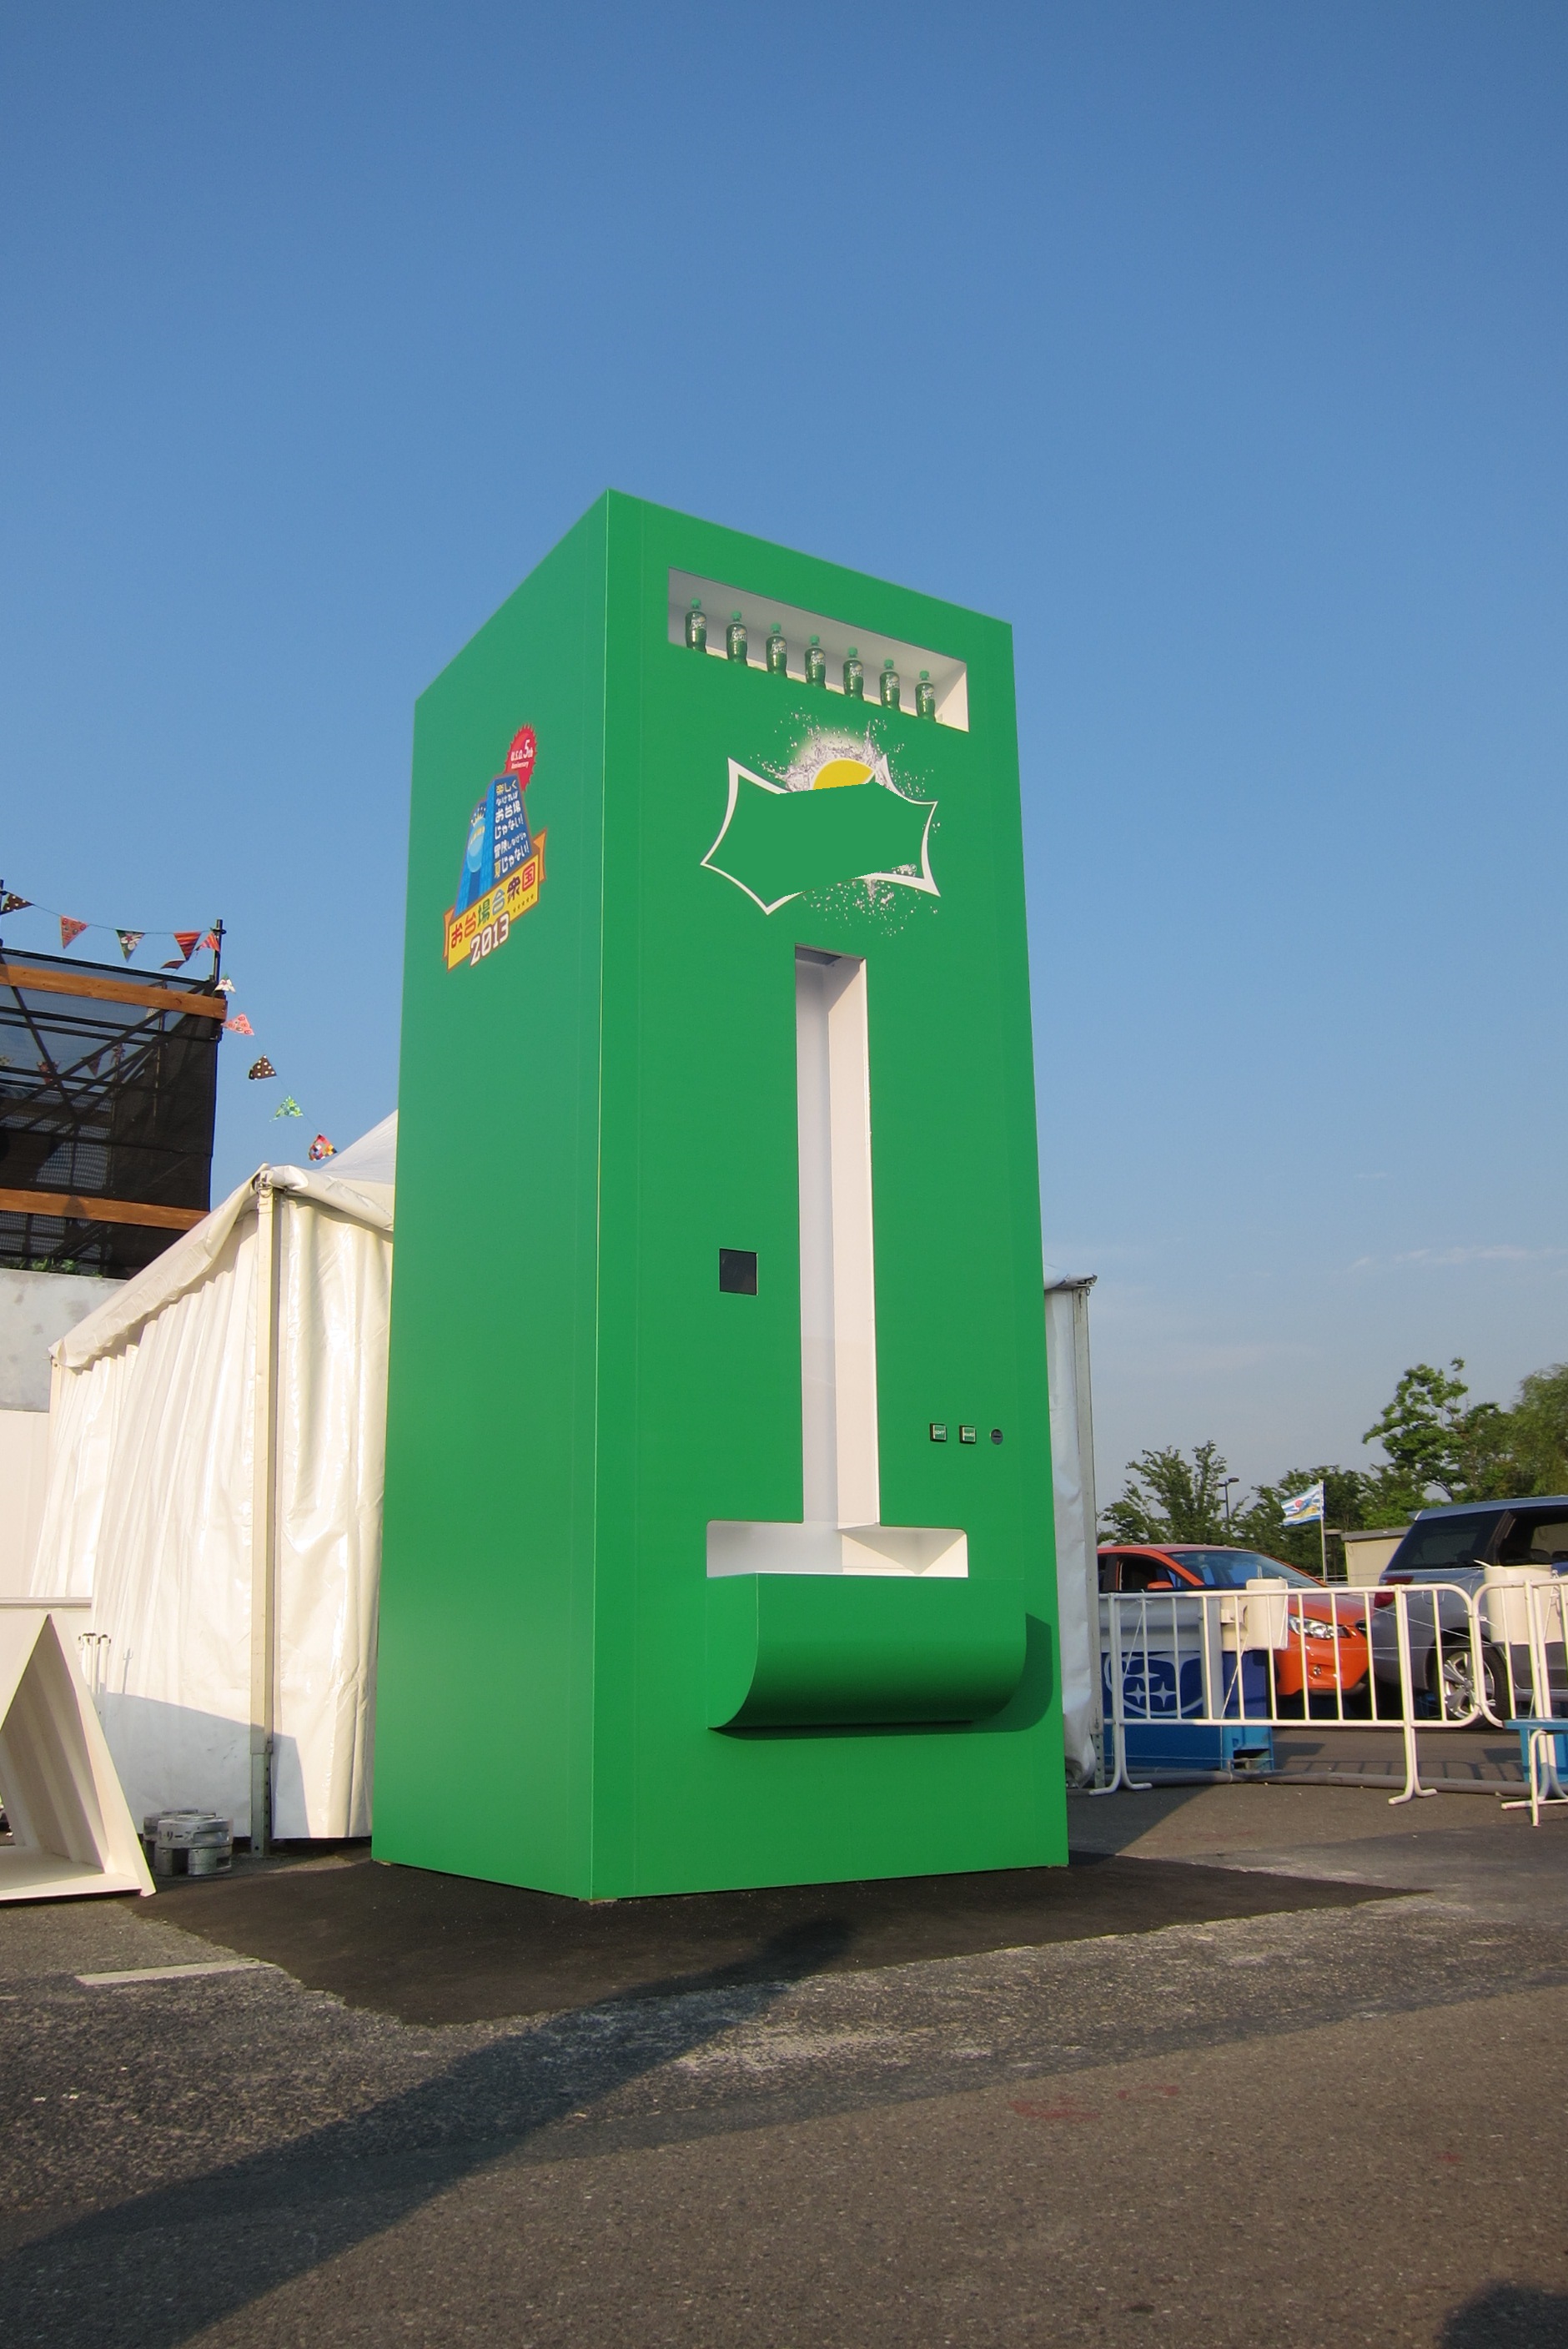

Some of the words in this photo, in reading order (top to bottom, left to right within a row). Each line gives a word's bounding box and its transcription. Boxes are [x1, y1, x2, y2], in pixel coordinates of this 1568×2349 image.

[495, 779, 518, 796] 楽しく
[495, 790, 519, 807] なければ
[495, 800, 521, 823] お台場
[451, 862, 535, 949] お台場合衆国
[470, 913, 510, 967] 2013
